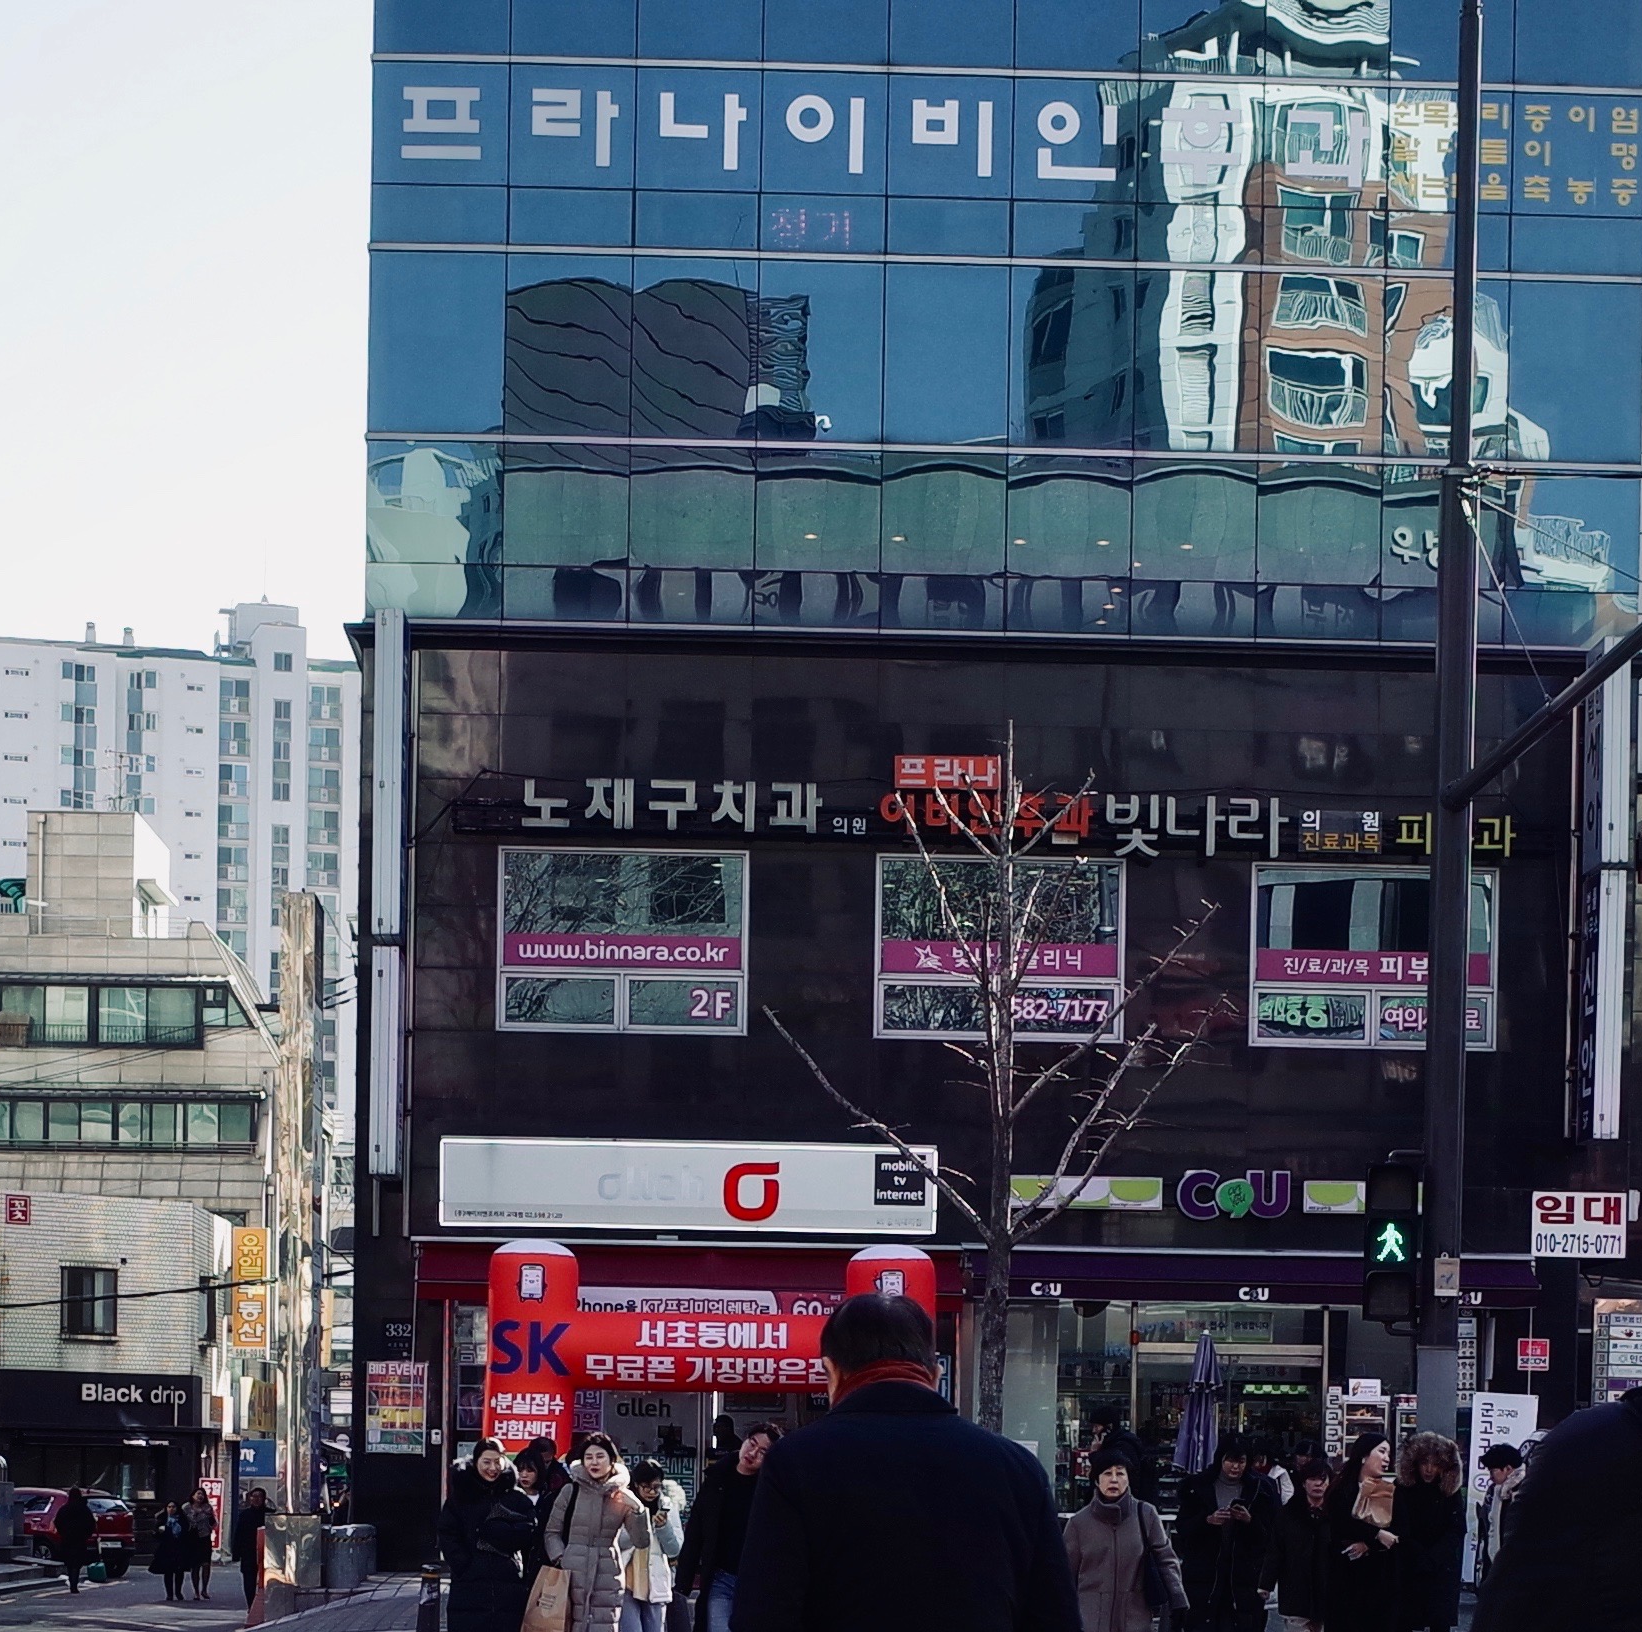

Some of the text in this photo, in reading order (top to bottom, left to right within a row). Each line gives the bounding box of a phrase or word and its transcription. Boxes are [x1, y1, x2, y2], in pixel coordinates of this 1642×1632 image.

[1393, 101, 1638, 134] 쉰목리 중이염
[400, 85, 1370, 188] 프라나이비인후과
[1524, 140, 1638, 171] 이명
[1524, 175, 1637, 206] 축농증
[899, 757, 997, 787] 프라나
[520, 776, 868, 836] 노재구치과 의원
[1105, 793, 1290, 858] 빛나라
[1395, 811, 1517, 859] 피과
[1301, 832, 1381, 853] 진료과목
[517, 938, 731, 965] www.binnara.co.kr
[1283, 957, 1371, 977] 진/료/과/목
[689, 986, 733, 1022] 2F
[876, 1188, 924, 1201] internet
[893, 1175, 907, 1187] tv
[1535, 1195, 1622, 1226] 임대
[1535, 1232, 1623, 1254] 010-2715-0771
[385, 1323, 412, 1337] 332
[635, 1320, 788, 1350] 서초동에서
[489, 1319, 572, 1377] SK
[368, 1363, 425, 1376] BIG EVENT
[585, 1353, 676, 1383] 무료폰
[81, 1382, 187, 1415] Black drip
[495, 1392, 566, 1415] 분실접수
[616, 1398, 671, 1418] olleh
[493, 1419, 557, 1441] 보험센터
